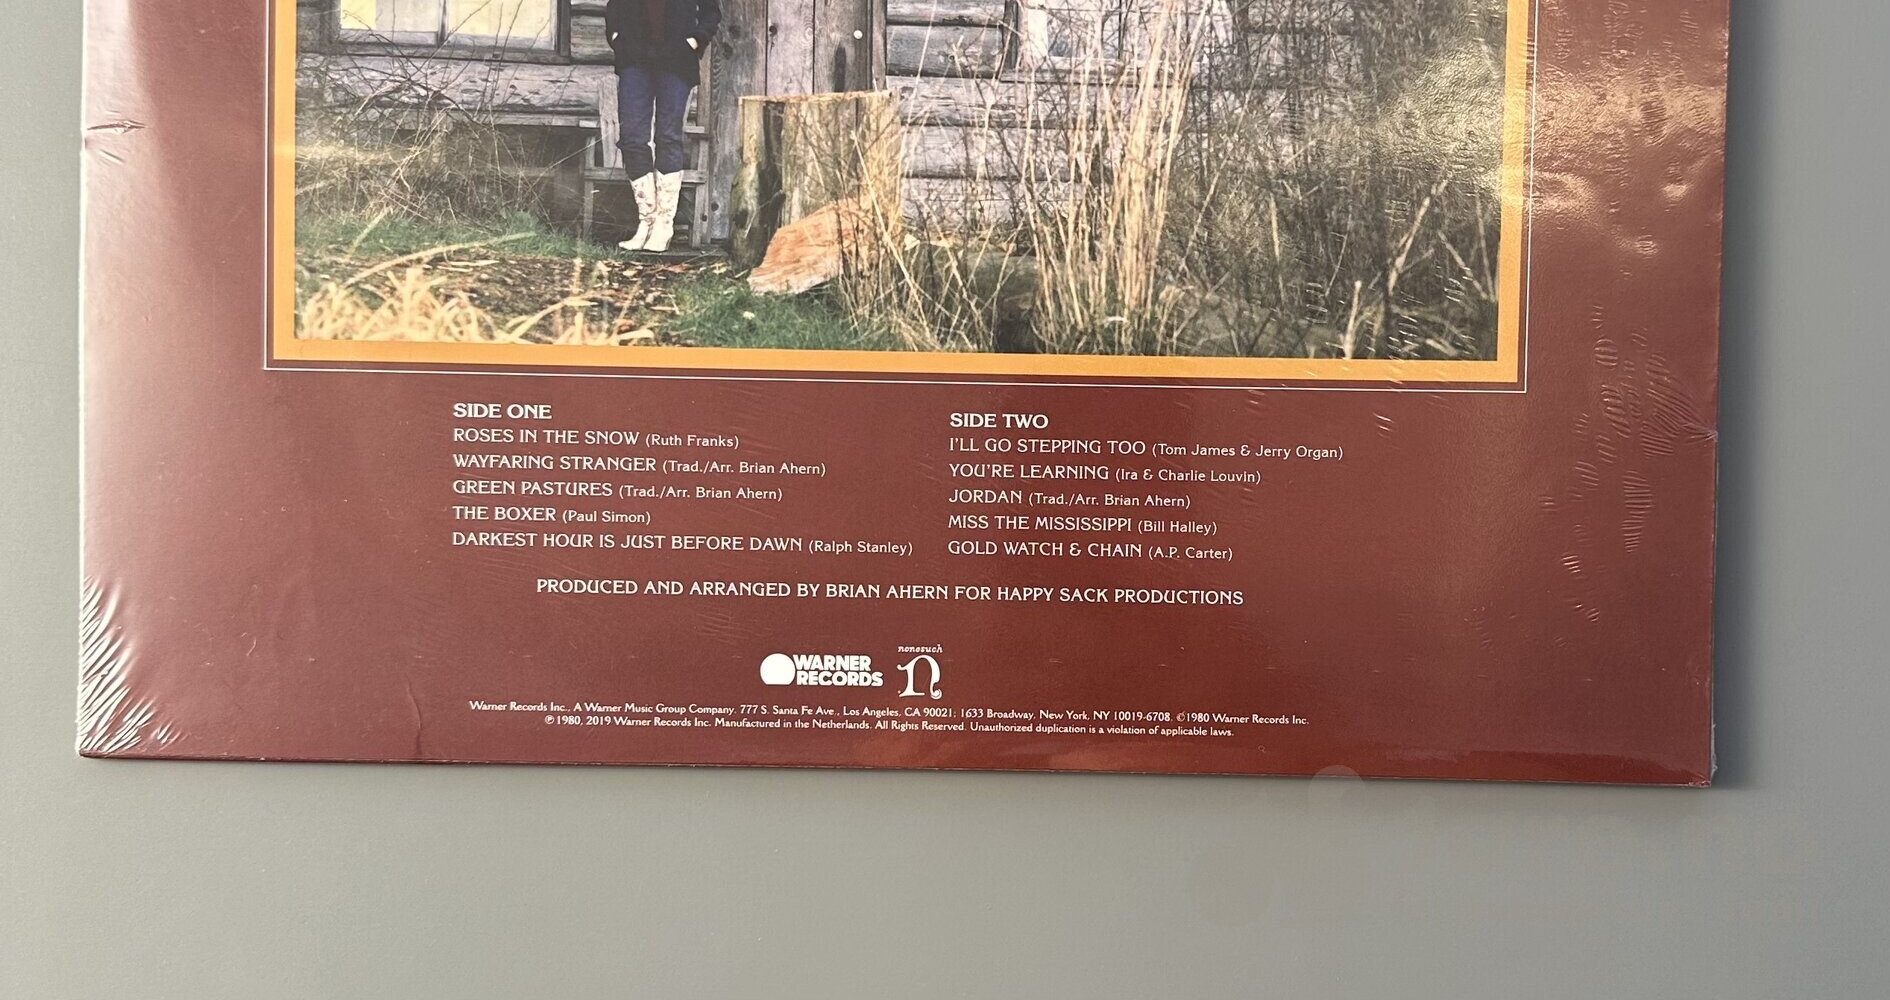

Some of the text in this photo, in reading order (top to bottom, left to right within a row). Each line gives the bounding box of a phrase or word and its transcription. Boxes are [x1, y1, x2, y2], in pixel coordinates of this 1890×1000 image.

[453, 403, 552, 419] SIDE ONE
[950, 413, 1049, 429] SIDE TWO
[454, 428, 739, 450] ROSES IN THE SNOW (Ruth Franks)
[950, 438, 1343, 461] I'LL GO STEPPING TOO (Tom James & Jerry Organ)
[453, 454, 826, 477] WAYFARING STRANGER (Trad./Arr. Brian Ahern)
[949, 464, 1261, 485] YOU'RE LEARNING (Ira & Charlie Louvin)
[453, 480, 782, 502] GREEN PASTURES (Trad./Arr. Brian Ahern)
[949, 489, 1190, 510] JORDAN (Trad./Arr. Brian Ahern)
[452, 506, 651, 525] THE BOXER (Paul Simon)
[948, 515, 1217, 536] MISS THE MISSISSIPPI (Bill Halley)
[453, 532, 913, 556] DARKEST HOUR IS JUST BEFORE DAWN (Ralph Stanley)
[948, 541, 1233, 562] GOLD WATCH & CHAIN (A.P. Carter)
[537, 579, 1243, 605] PRODUCED AND ARRANGED BY BRIAN AHERN FOR HAPPY SACK PRODUCTIONS
[897, 644, 943, 653] nonesuch
[793, 655, 871, 671] WARNER
[796, 671, 884, 687] RECORDS
[469, 701, 507, 711] Warner
[509, 702, 548, 712] Records
[573, 702, 583, 713] A
[584, 703, 621, 713] Warner
[624, 703, 653, 714] Music
[655, 704, 687, 717] Group
[740, 705, 758, 716] 777
[772, 706, 799, 716] Santa
[801, 706, 813, 717] Fe
[843, 707, 860, 718] Los
[862, 707, 902, 721] Angeles,
[904, 708, 921, 719] CA
[961, 709, 984, 720] 1633
[986, 710, 1036, 723] Broadway,
[1039, 710, 1064, 721] New
[1065, 711, 1090, 723] York,
[1093, 711, 1111, 722] NY
[1212, 713, 1249, 724] Warner
[1252, 714, 1290, 725] Records
[1292, 715, 1309, 725] Inc.
[586, 716, 612, 726] 2019
[613, 716, 651, 727] Warner
[653, 717, 692, 727] Records
[694, 717, 712, 728] Inc.
[714, 718, 780, 729] Manufactured
[783, 719, 792, 729] in
[794, 719, 809, 729] the
[812, 720, 872, 730] Netherlands.
[875, 720, 889, 731] All
[891, 721, 919, 734] Rights
[922, 721, 966, 732] Reserved.
[970, 722, 1033, 733] Unauthorized
[1035, 723, 1086, 736] duplication
[1088, 724, 1096, 734] is
[1107, 724, 1146, 735] violation
[1148, 725, 1160, 735] of
[1160, 725, 1208, 738] applicable
[1210, 726, 1234, 736] laws.
